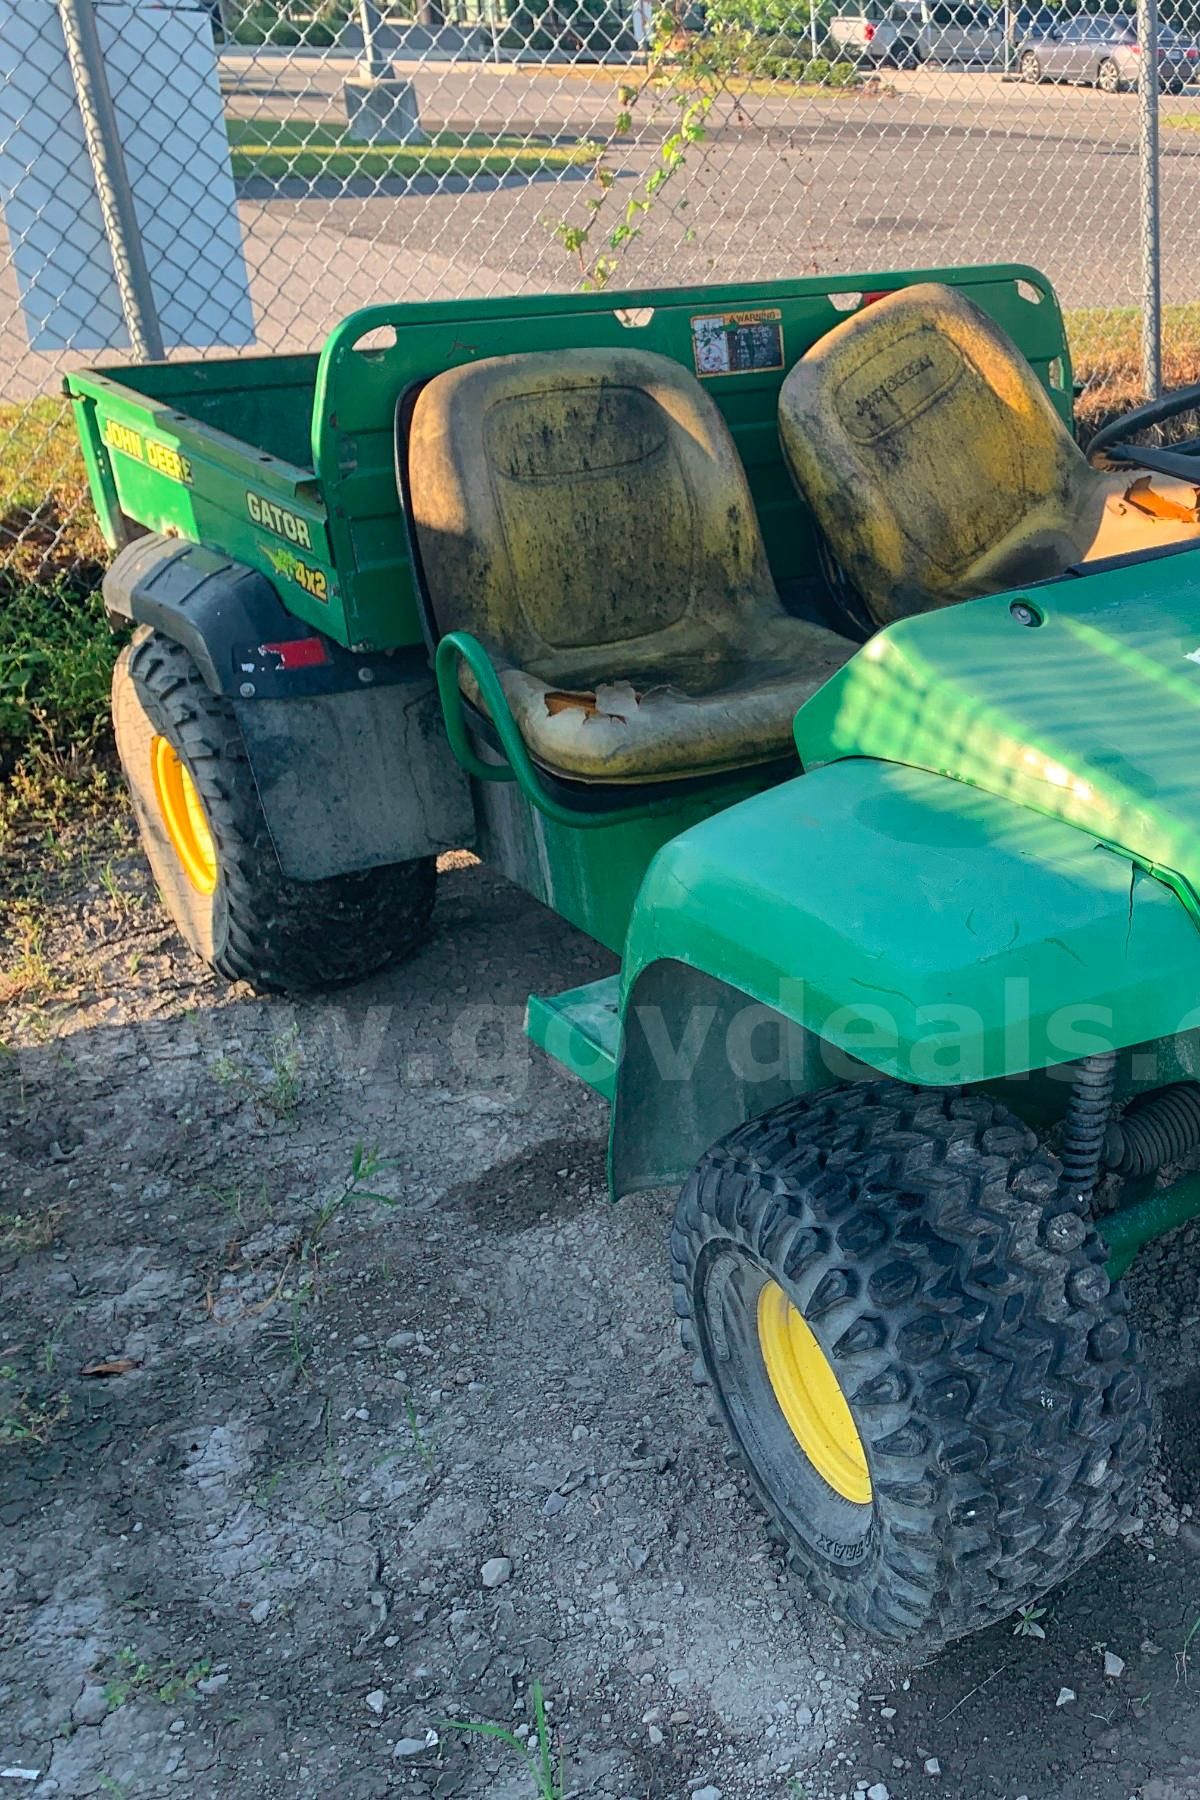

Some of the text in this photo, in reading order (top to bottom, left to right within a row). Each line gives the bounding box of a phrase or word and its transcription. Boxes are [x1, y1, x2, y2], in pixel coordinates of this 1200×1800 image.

[736, 311, 776, 322] WARNING
[105, 419, 194, 486] JOHN DEERE
[246, 490, 313, 550] GATOR
[295, 559, 328, 605] 4x2
